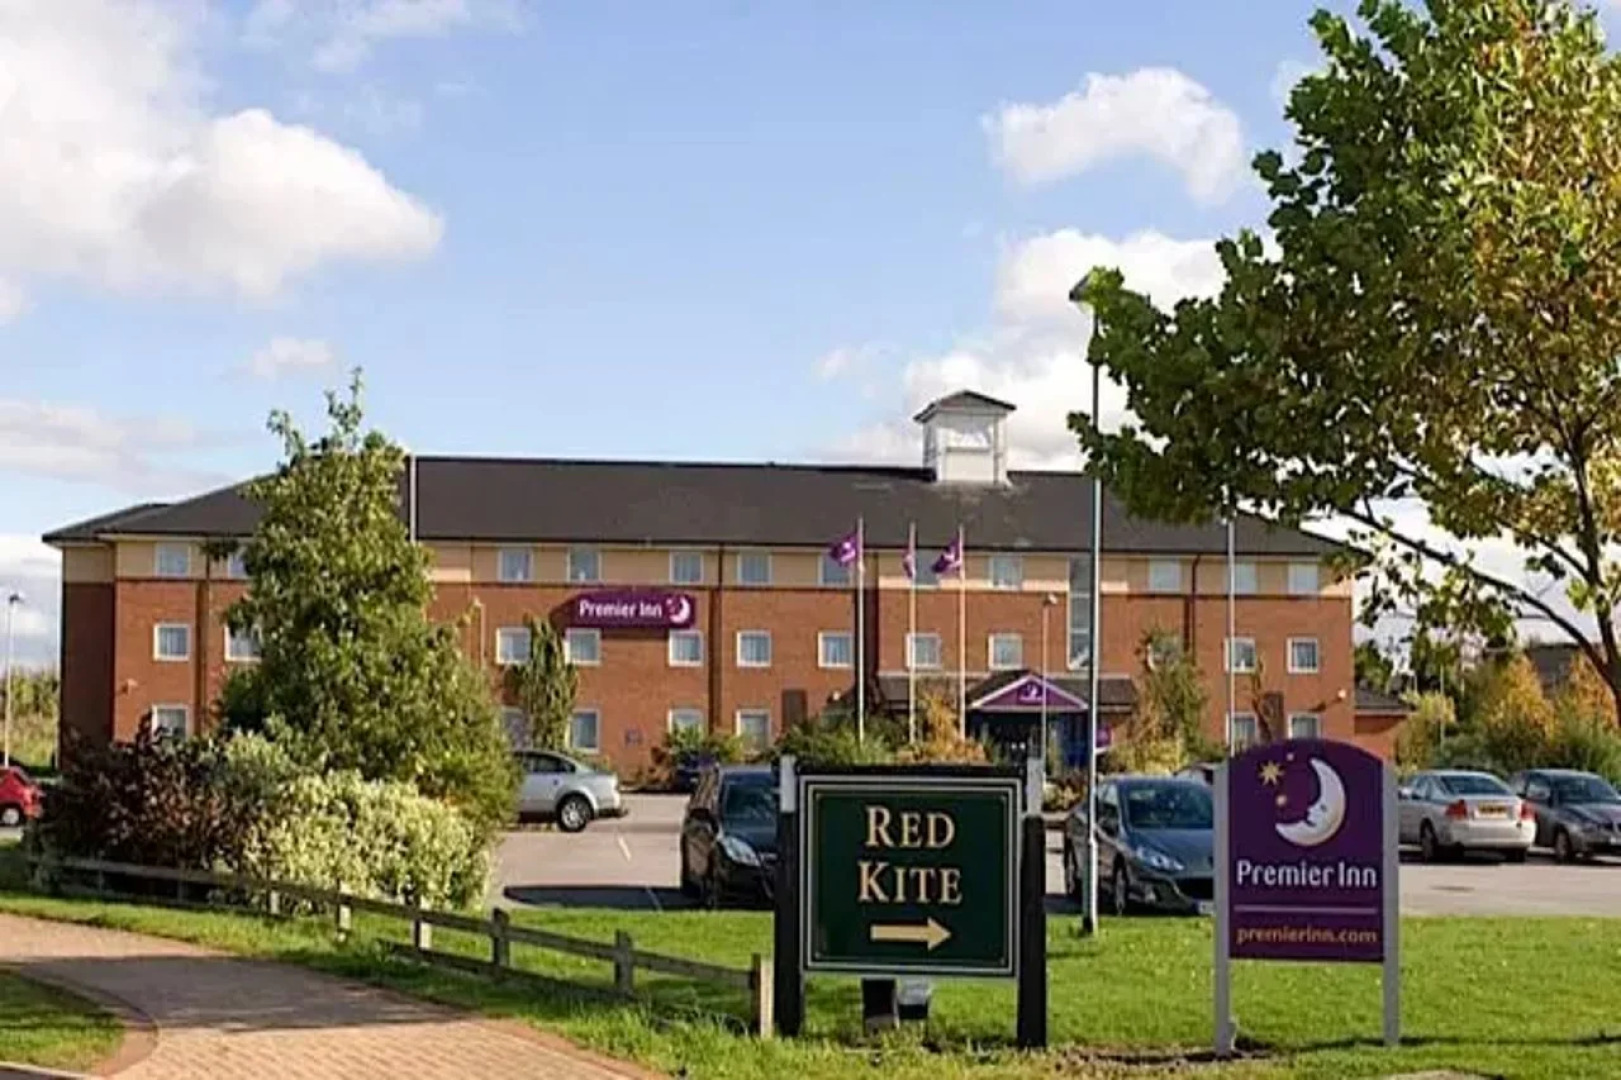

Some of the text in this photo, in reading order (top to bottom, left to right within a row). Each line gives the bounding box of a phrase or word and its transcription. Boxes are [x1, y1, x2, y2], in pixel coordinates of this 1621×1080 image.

[579, 599, 662, 617] Premier Inn
[865, 806, 955, 847] RED
[858, 862, 962, 904] KITE
[1237, 860, 1376, 887] Premier Inn
